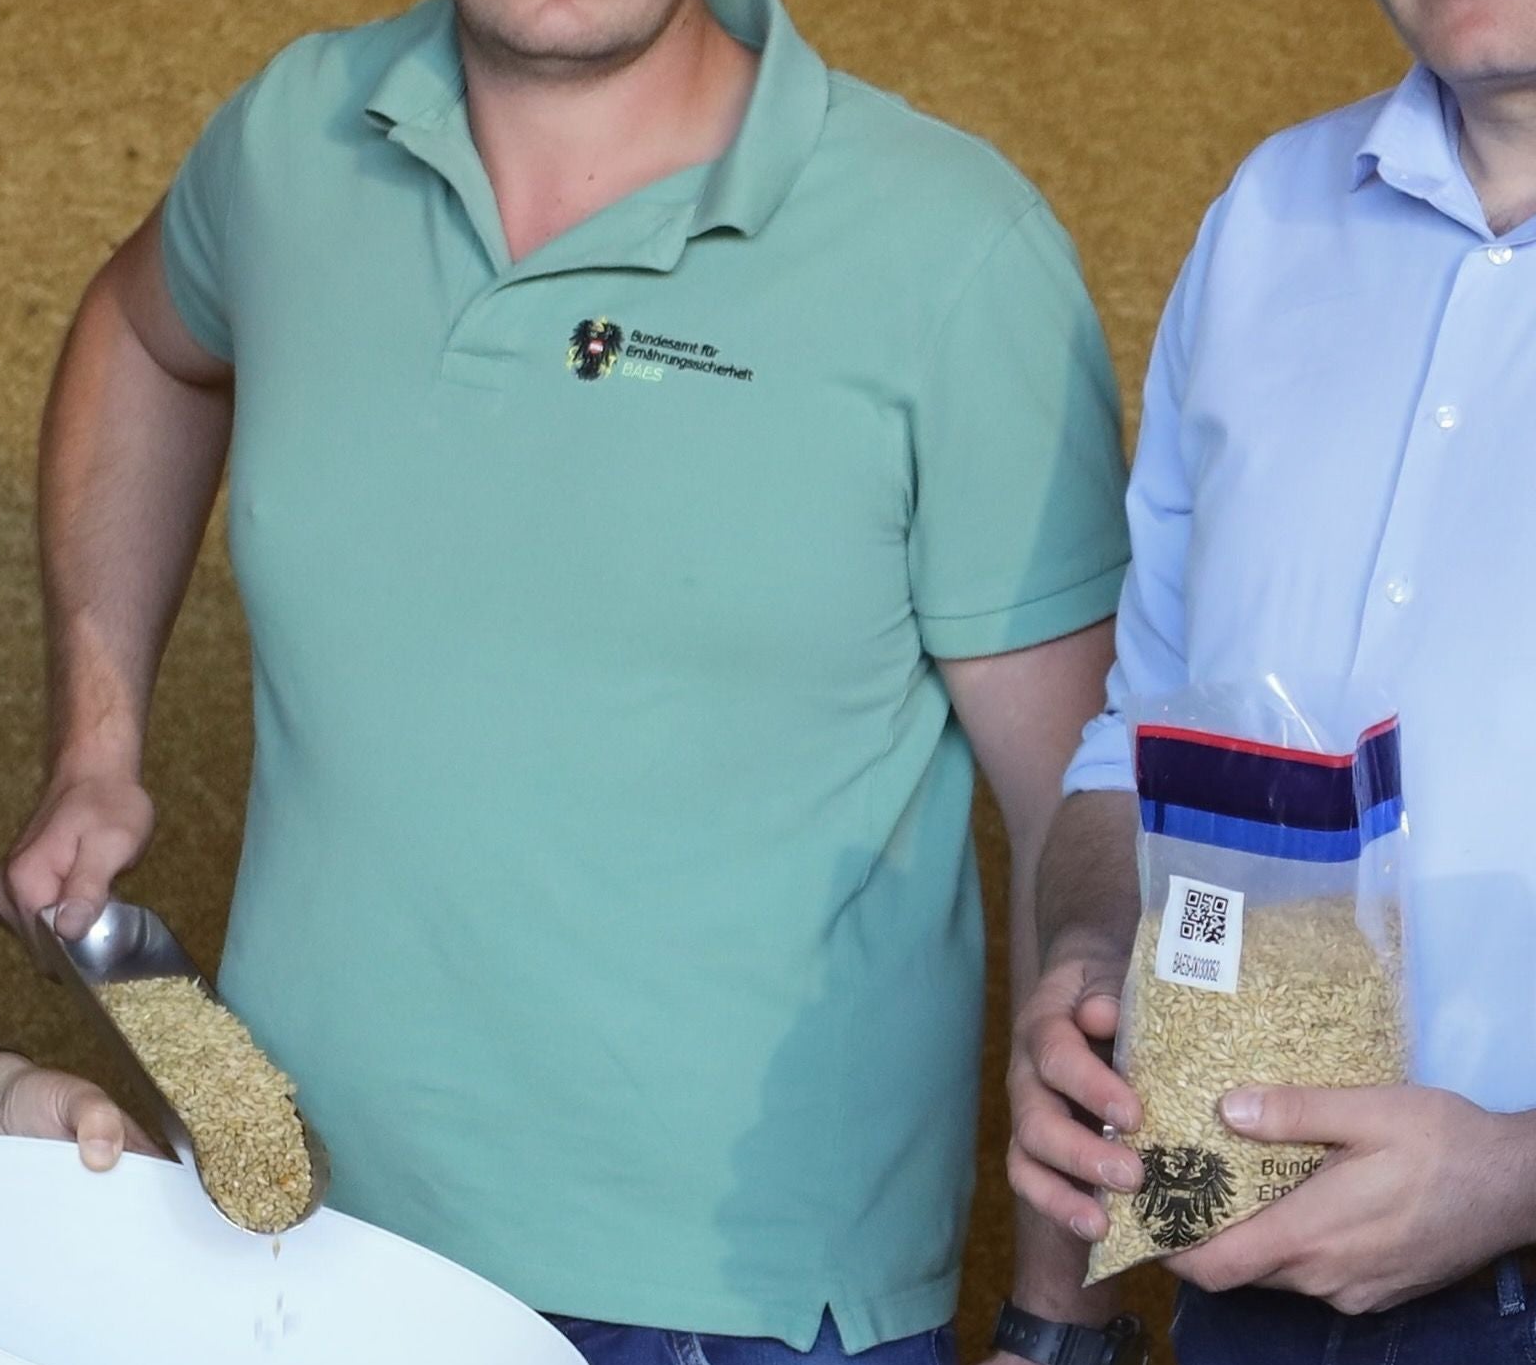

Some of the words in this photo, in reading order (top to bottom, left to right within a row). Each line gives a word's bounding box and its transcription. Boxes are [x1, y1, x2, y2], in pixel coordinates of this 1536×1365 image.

[630, 329, 698, 354] Bundesamt
[700, 343, 720, 358] für
[622, 362, 664, 382] BAES
[625, 345, 754, 382] Ernährungssicherheit
[1262, 1155, 1324, 1176] Bunde
